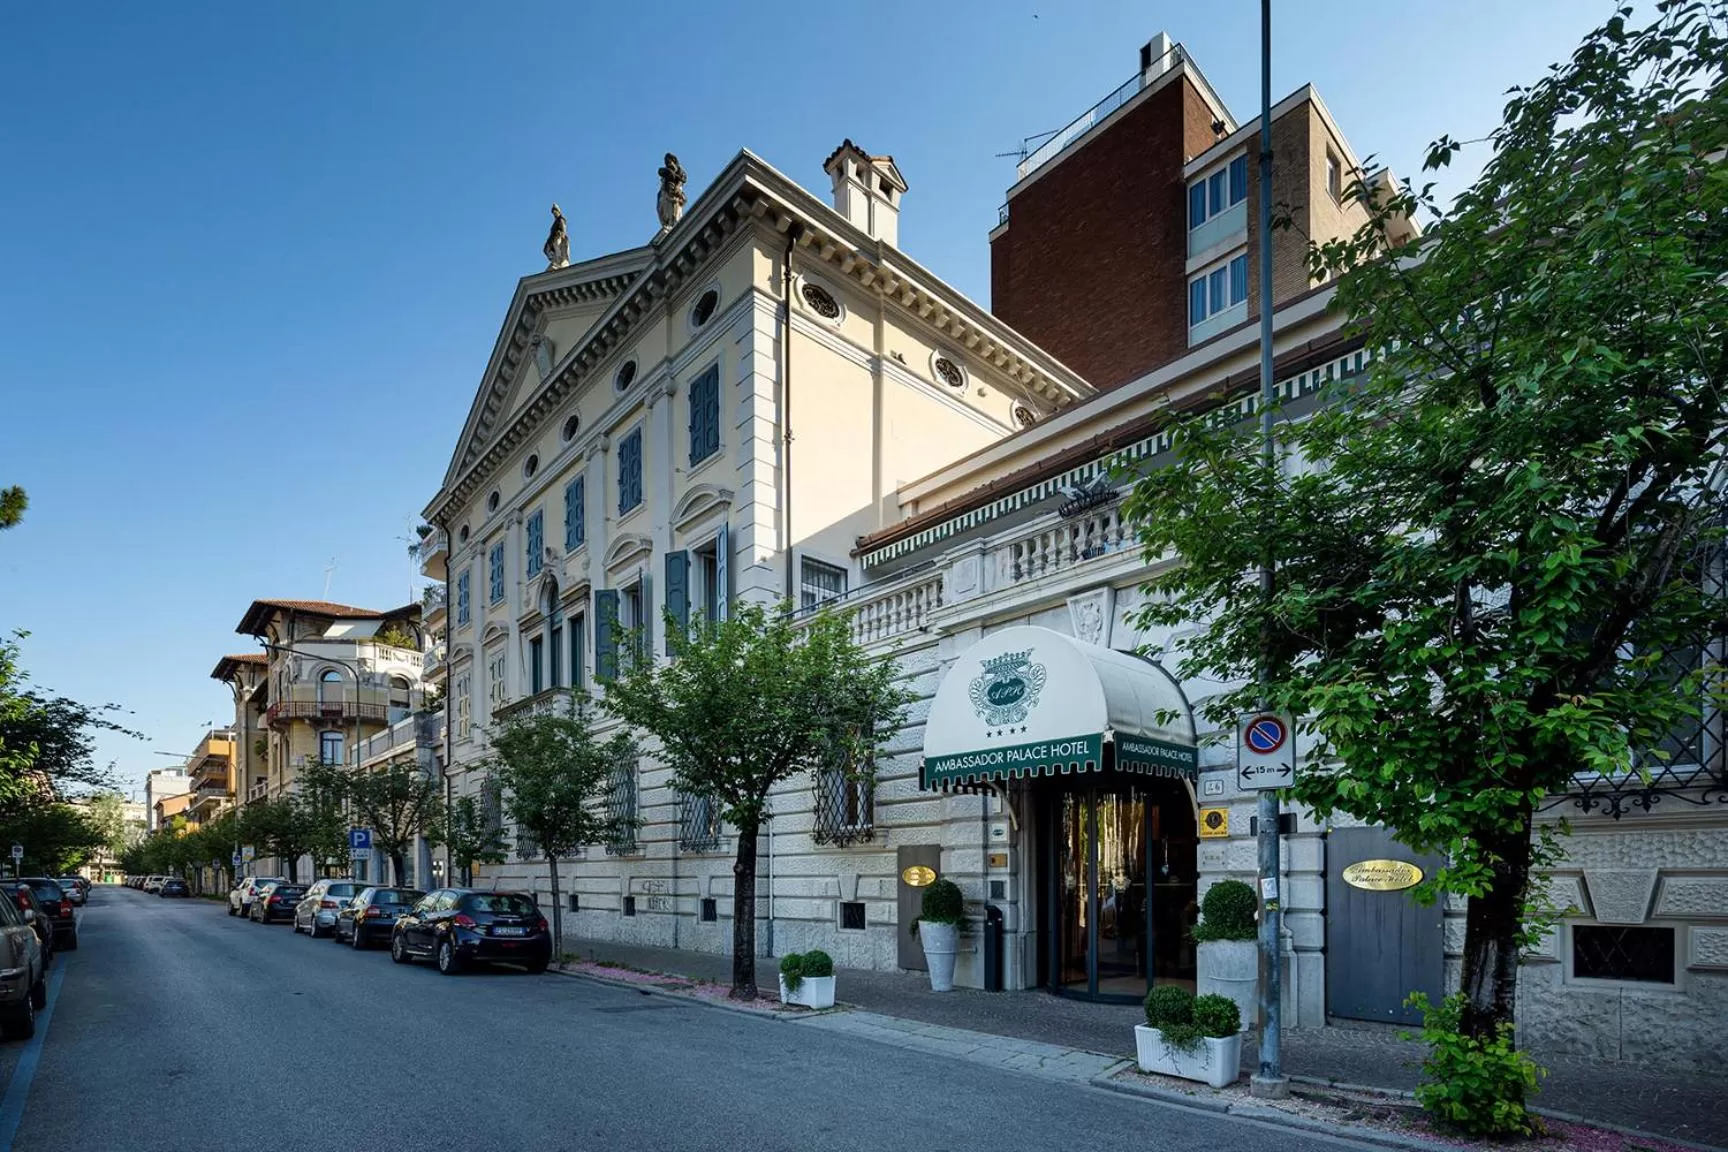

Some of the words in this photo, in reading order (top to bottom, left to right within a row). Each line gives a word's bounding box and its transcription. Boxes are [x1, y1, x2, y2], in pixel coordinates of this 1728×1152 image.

[934, 751, 1004, 773] AMBASSADOR
[1006, 745, 1048, 762] PALACE
[1050, 740, 1090, 757] HOTEL
[1122, 742, 1160, 757] AMBASSADOR
[1160, 747, 1178, 760] PALACE
[1179, 751, 1193, 762] HOTEL
[1256, 765, 1265, 774] 15
[354, 832, 366, 846] P
